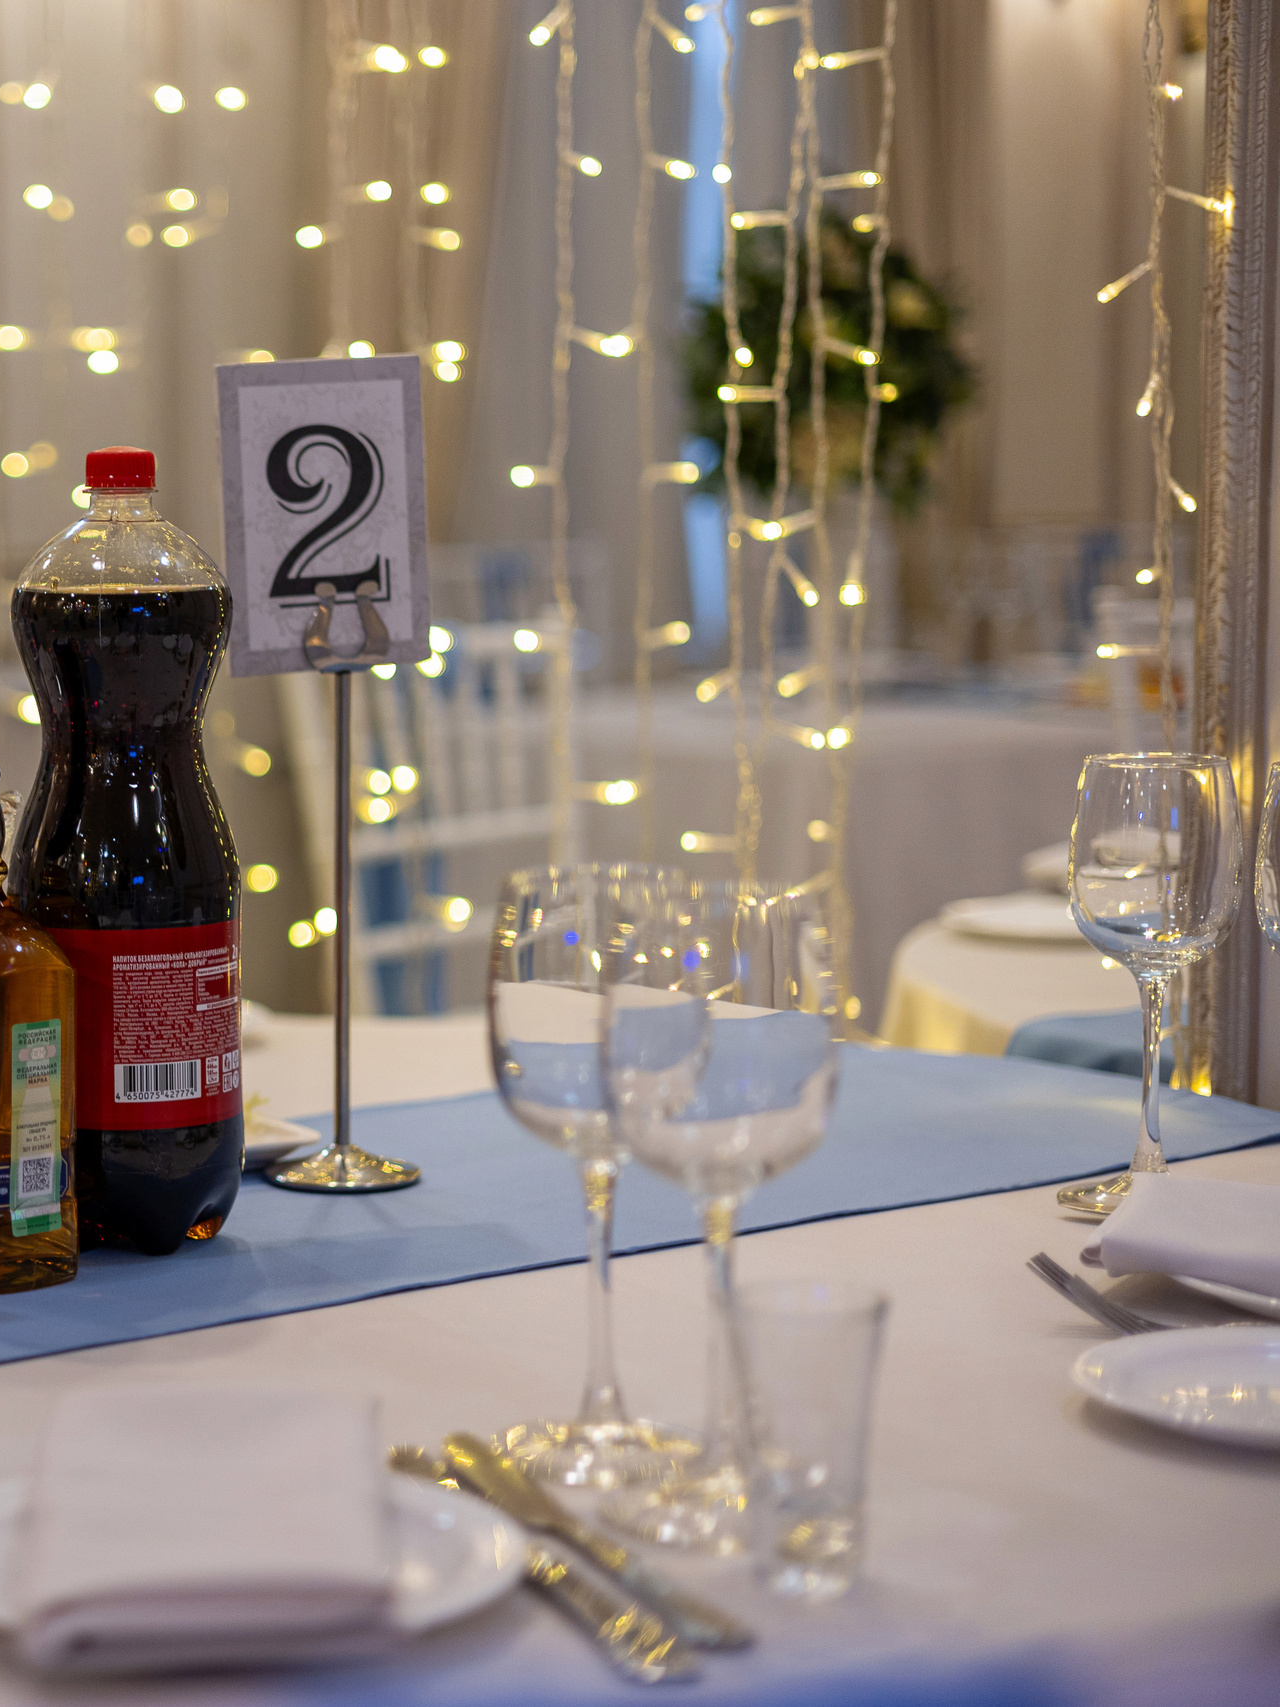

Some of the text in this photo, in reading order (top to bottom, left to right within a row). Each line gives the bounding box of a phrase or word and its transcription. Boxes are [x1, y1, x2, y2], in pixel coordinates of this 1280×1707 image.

[266, 424, 390, 608] 2
[112, 945, 228, 963] НАПИТОК БЕЗАЛКОГОЛЬНЫЙ СИЛЬНОГАЗИРОВАННЫЙ
[112, 961, 170, 971] АРОМАТИЗИРОВАННЫЙ
[18, 1028, 56, 1039] РОССИЙСКАЯ
[18, 1035, 56, 1045] ФЕДЕРАЦИЯ
[16, 1062, 57, 1073] ФЕДЕРАЛЬНАЯ
[16, 1069, 57, 1080] СПЕЦИАЛЬНАЯ
[127, 1091, 160, 1100] 650075
[164, 1089, 195, 1098] 427774
